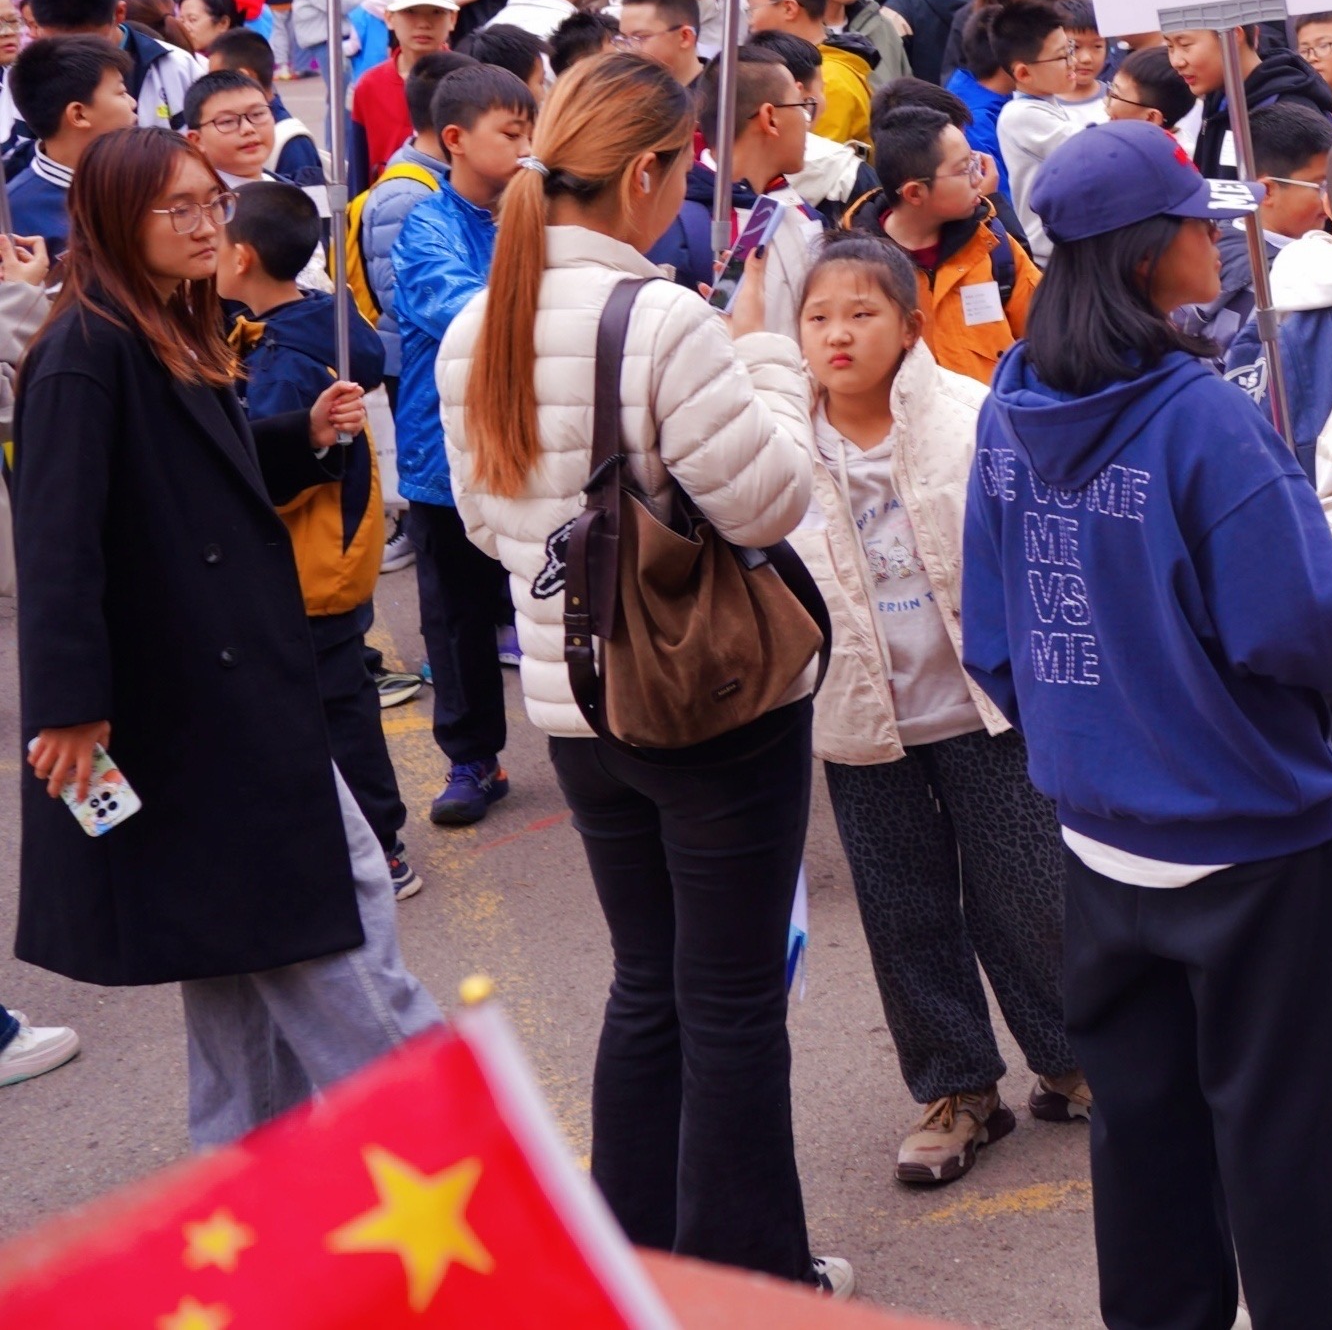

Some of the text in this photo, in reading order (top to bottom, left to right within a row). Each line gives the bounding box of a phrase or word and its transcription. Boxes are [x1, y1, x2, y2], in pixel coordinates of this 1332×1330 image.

[1024, 511, 1082, 570] ME
[1028, 570, 1091, 625] VS
[1031, 630, 1100, 686] ME
